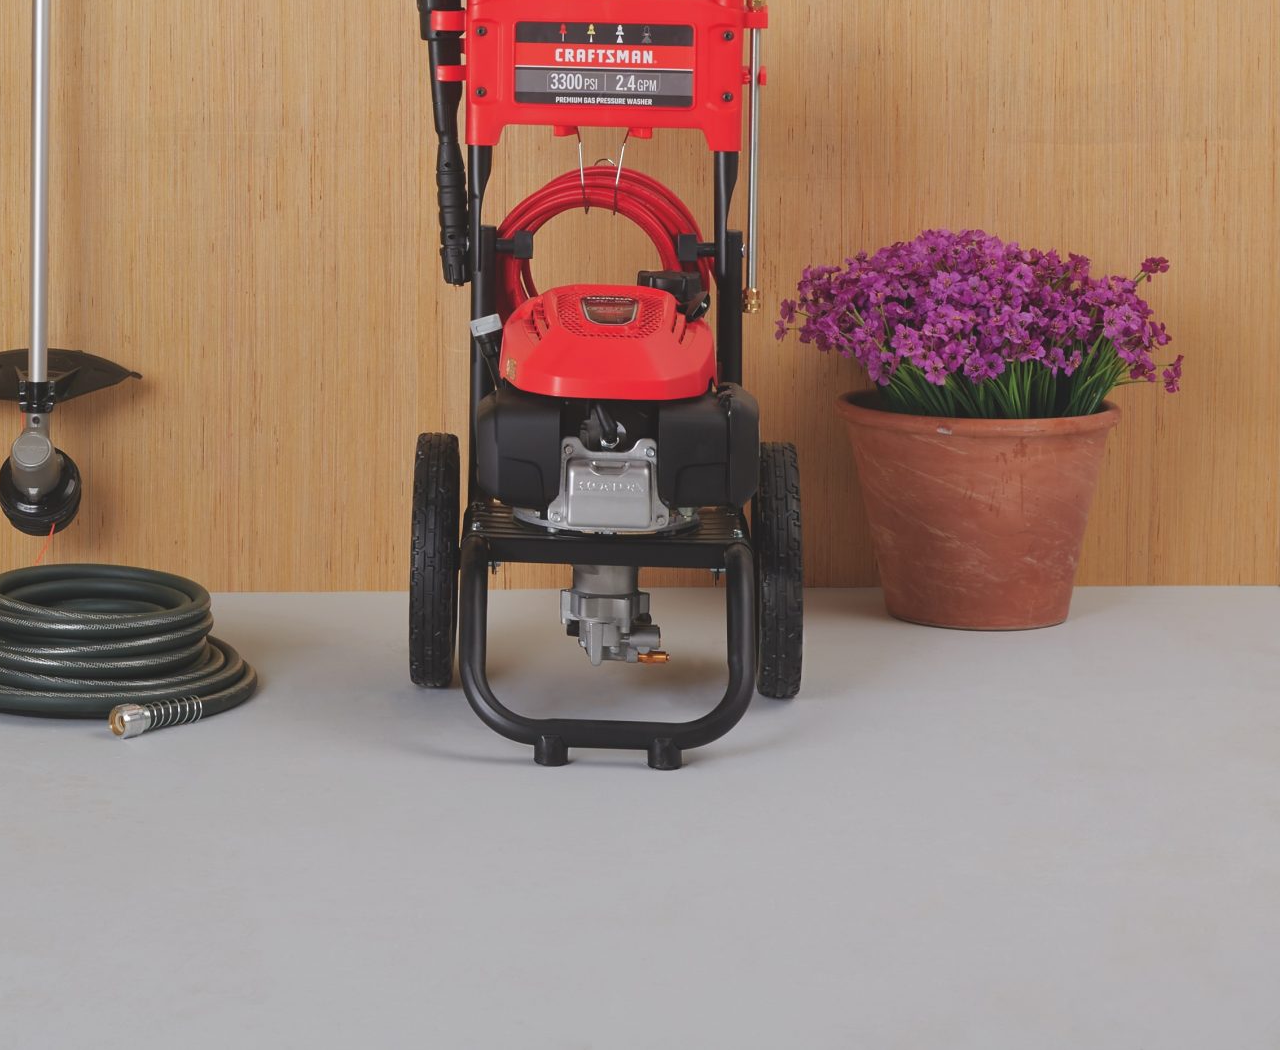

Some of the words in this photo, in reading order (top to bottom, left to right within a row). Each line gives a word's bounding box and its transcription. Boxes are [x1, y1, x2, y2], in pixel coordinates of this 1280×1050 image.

[555, 48, 653, 64] CRAFTSMAN
[550, 73, 582, 90] 3300
[584, 78, 598, 90] PSI
[616, 74, 636, 91] 2.4
[637, 79, 657, 92] GPM
[555, 96, 582, 104] PREMIUM
[627, 98, 653, 106] WASHER
